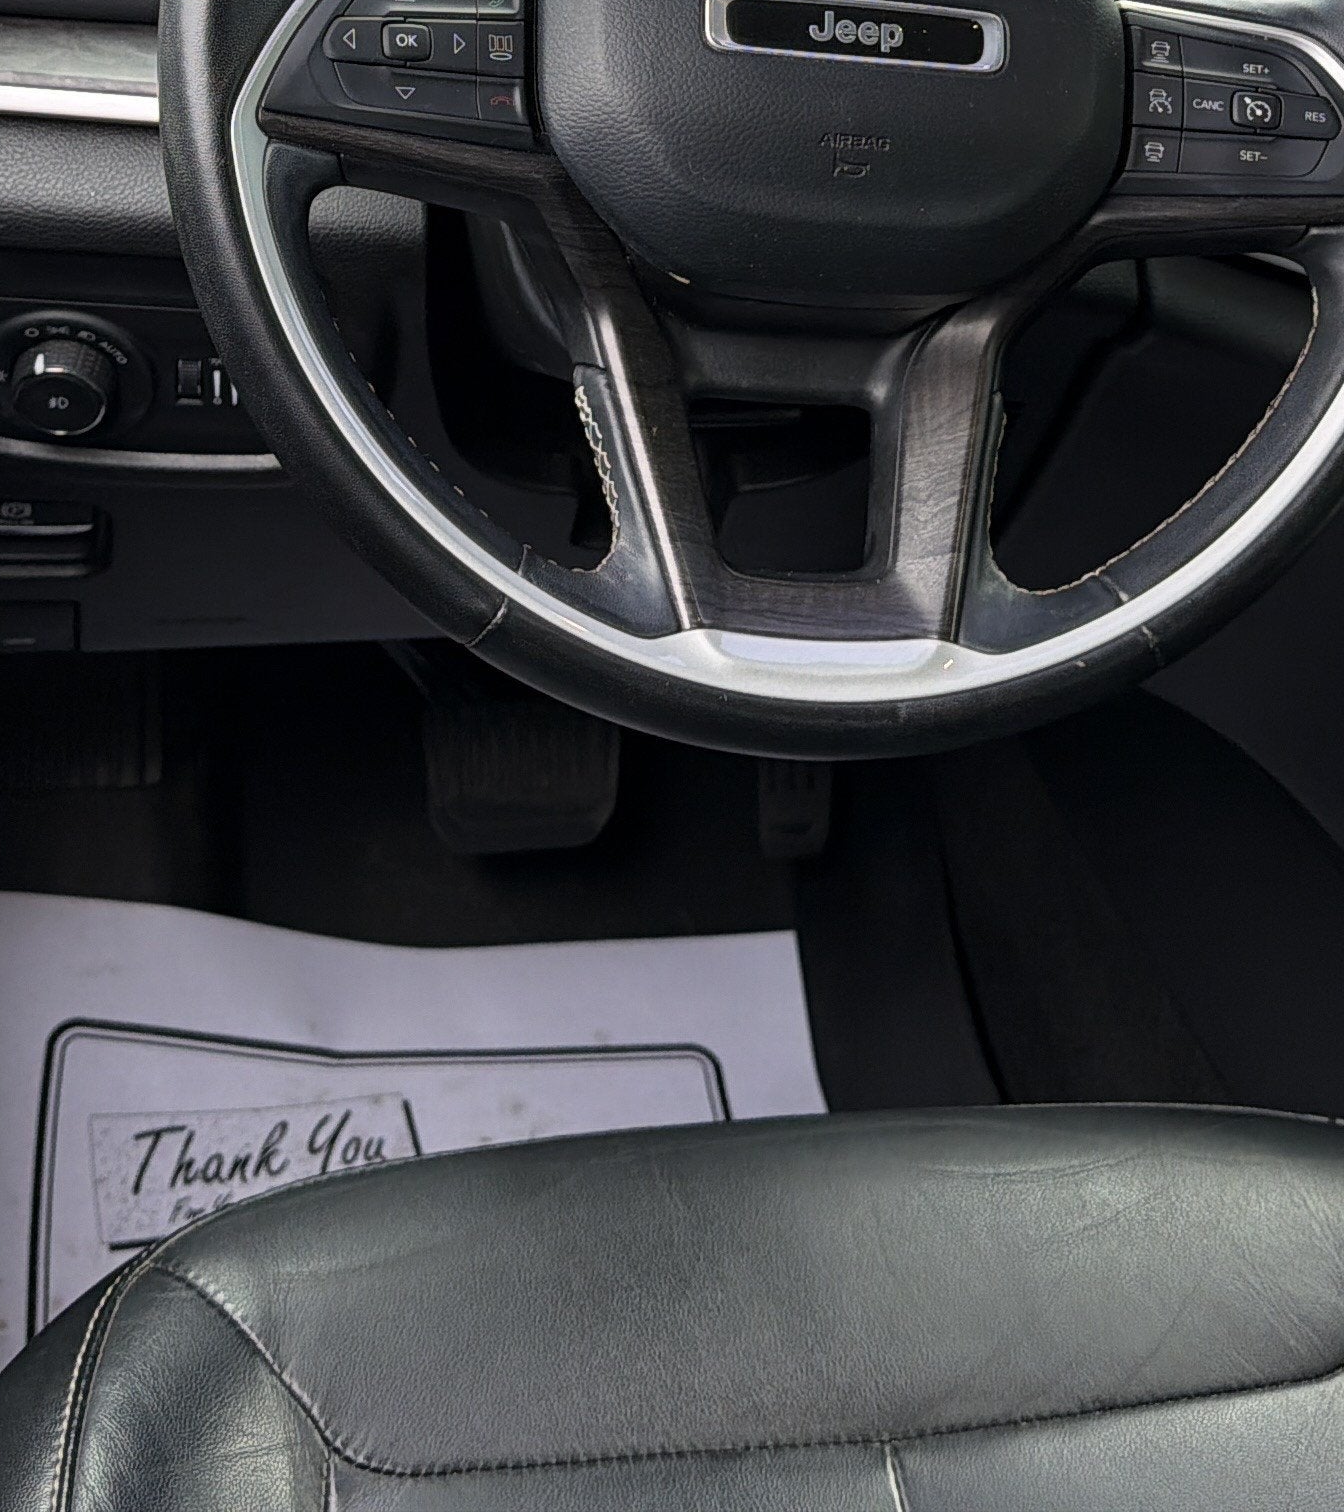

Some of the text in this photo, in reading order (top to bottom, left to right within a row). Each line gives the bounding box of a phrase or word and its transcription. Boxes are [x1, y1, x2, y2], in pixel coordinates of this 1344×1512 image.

[808, 10, 905, 54] Jeep
[395, 33, 419, 48] OK
[1242, 63, 1270, 75] SET+
[1192, 98, 1225, 112] CANC
[1304, 111, 1327, 124] RES
[819, 131, 892, 153] AIRBAG
[133, 1108, 388, 1196] Thank You
